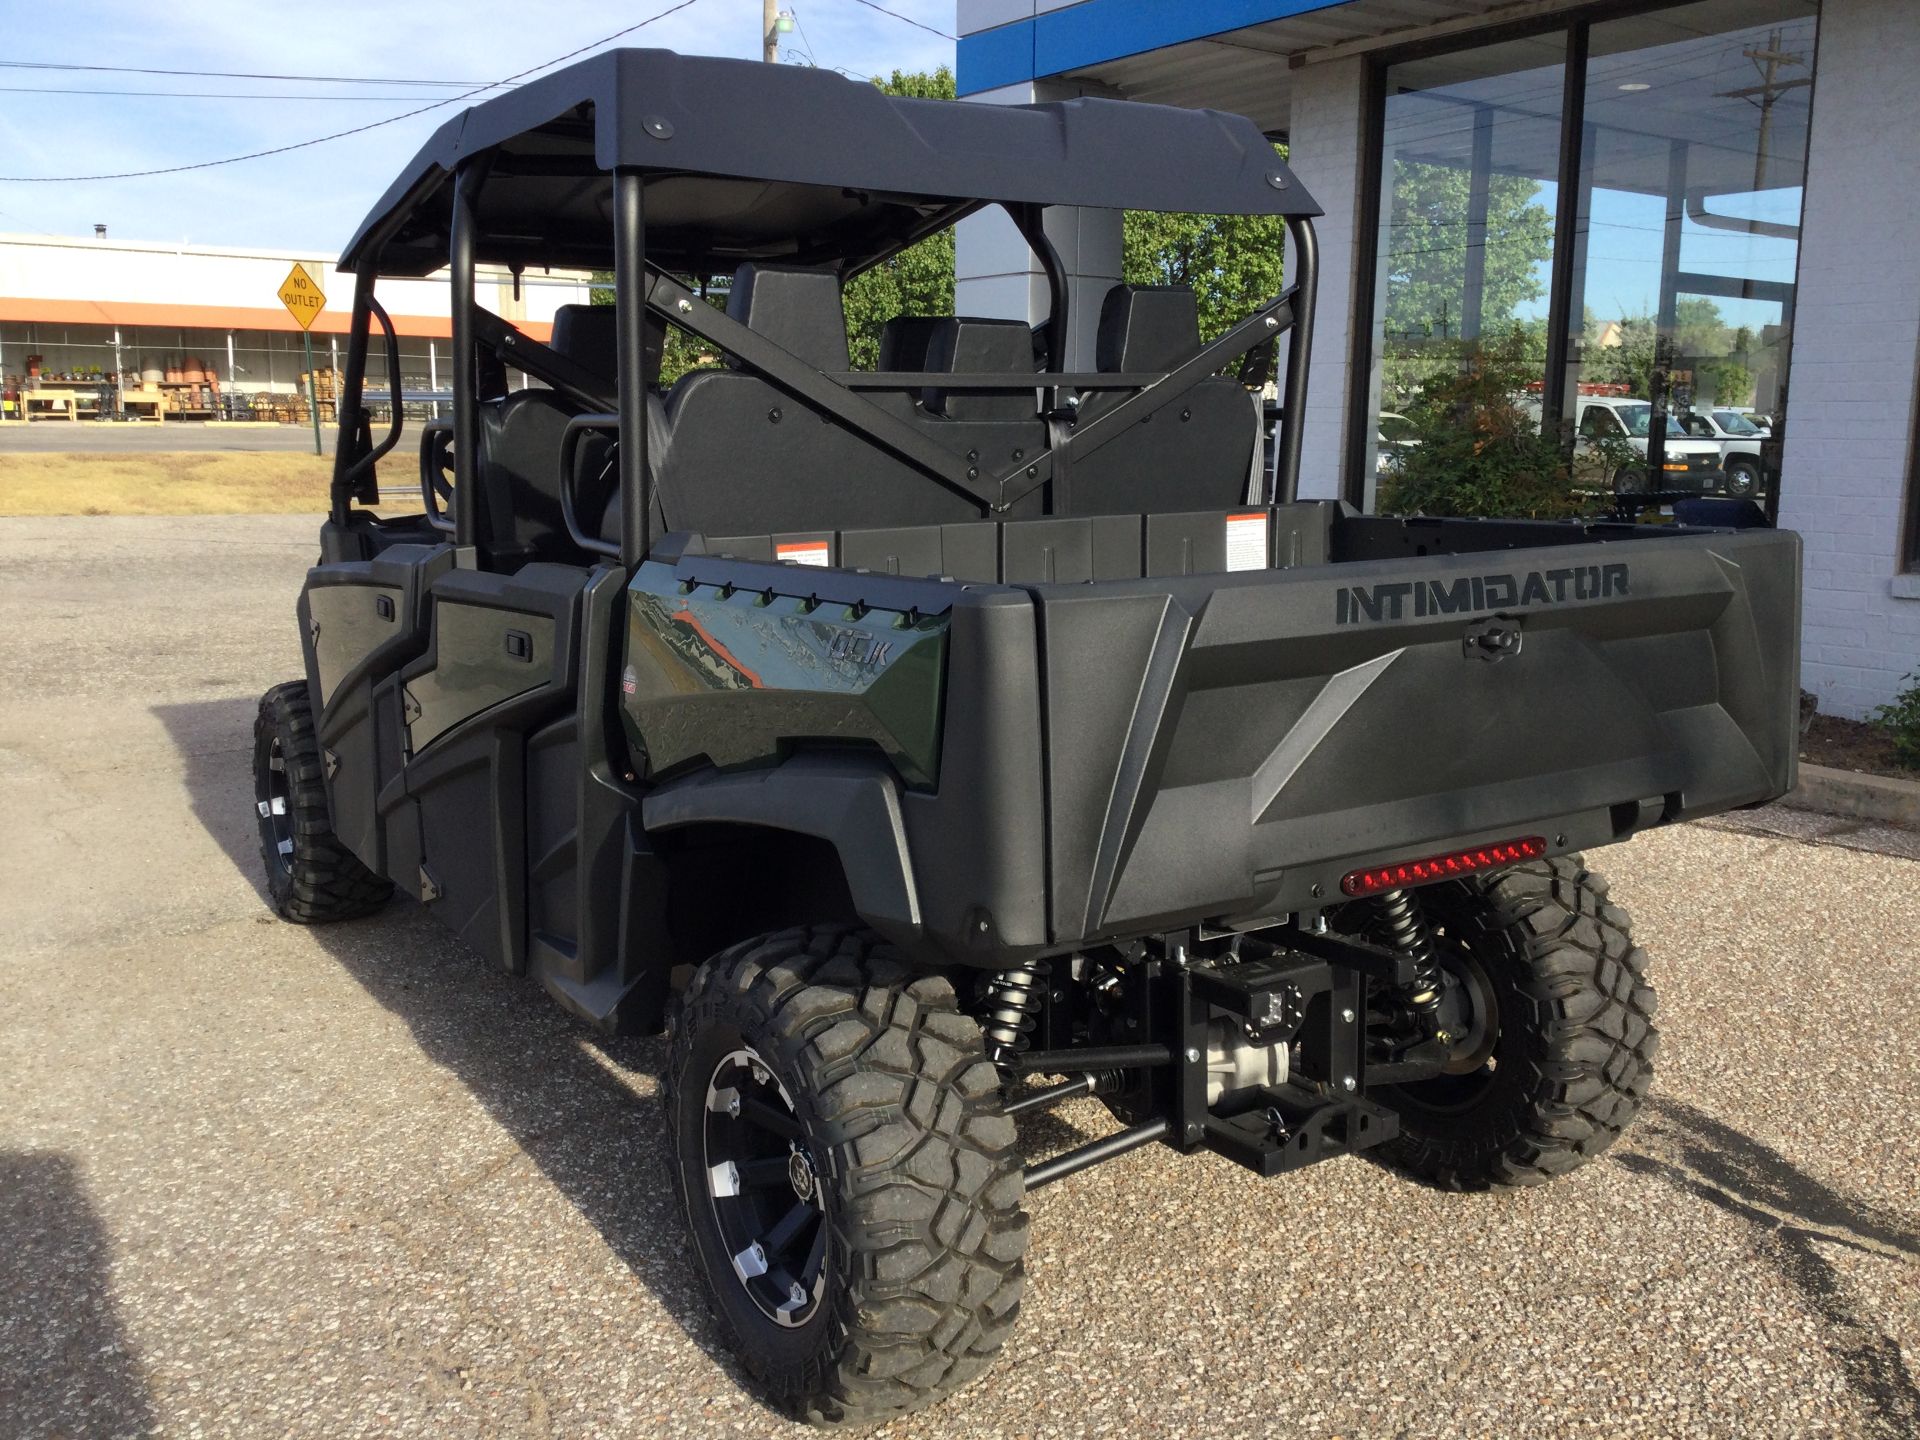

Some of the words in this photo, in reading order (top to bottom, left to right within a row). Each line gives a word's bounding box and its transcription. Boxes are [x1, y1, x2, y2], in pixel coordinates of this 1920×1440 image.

[293, 277, 307, 290] NO
[284, 293, 320, 308] OUTLET
[1336, 563, 1629, 625] INTIMIDATOR
